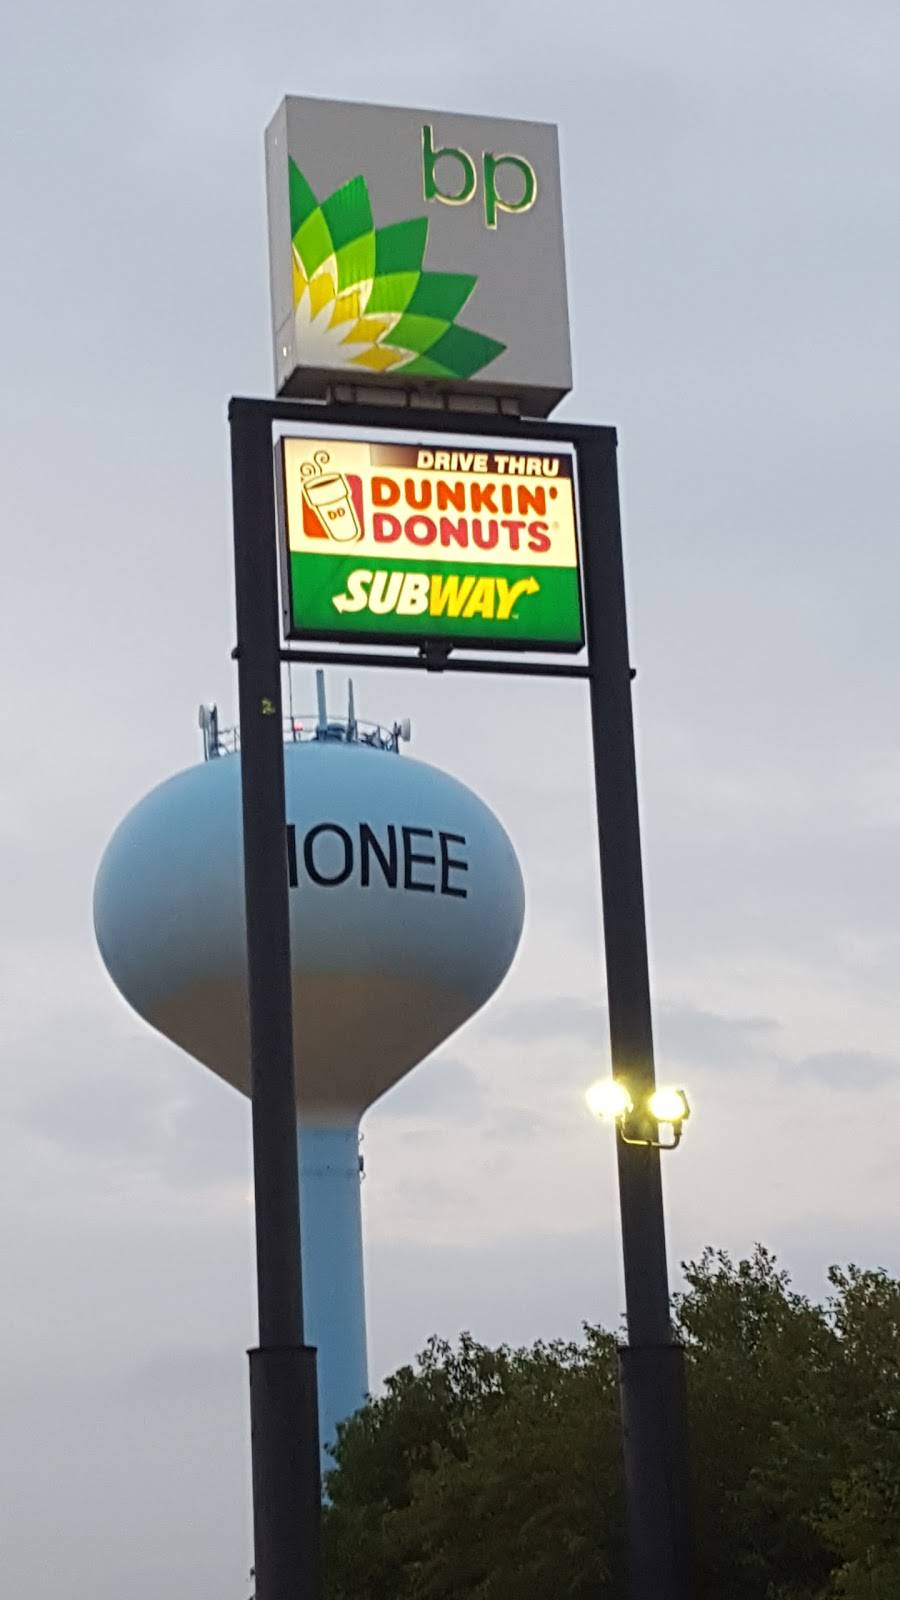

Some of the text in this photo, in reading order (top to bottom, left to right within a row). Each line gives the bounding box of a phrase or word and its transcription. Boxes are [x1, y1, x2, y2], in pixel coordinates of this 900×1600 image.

[421, 124, 538, 230] bp
[416, 450, 560, 477] DRIVE THRU
[371, 476, 558, 516] DUNKIN'
[372, 512, 552, 553] DONUTS
[332, 568, 541, 620] SUBWAY
[286, 822, 469, 899] ONEE
